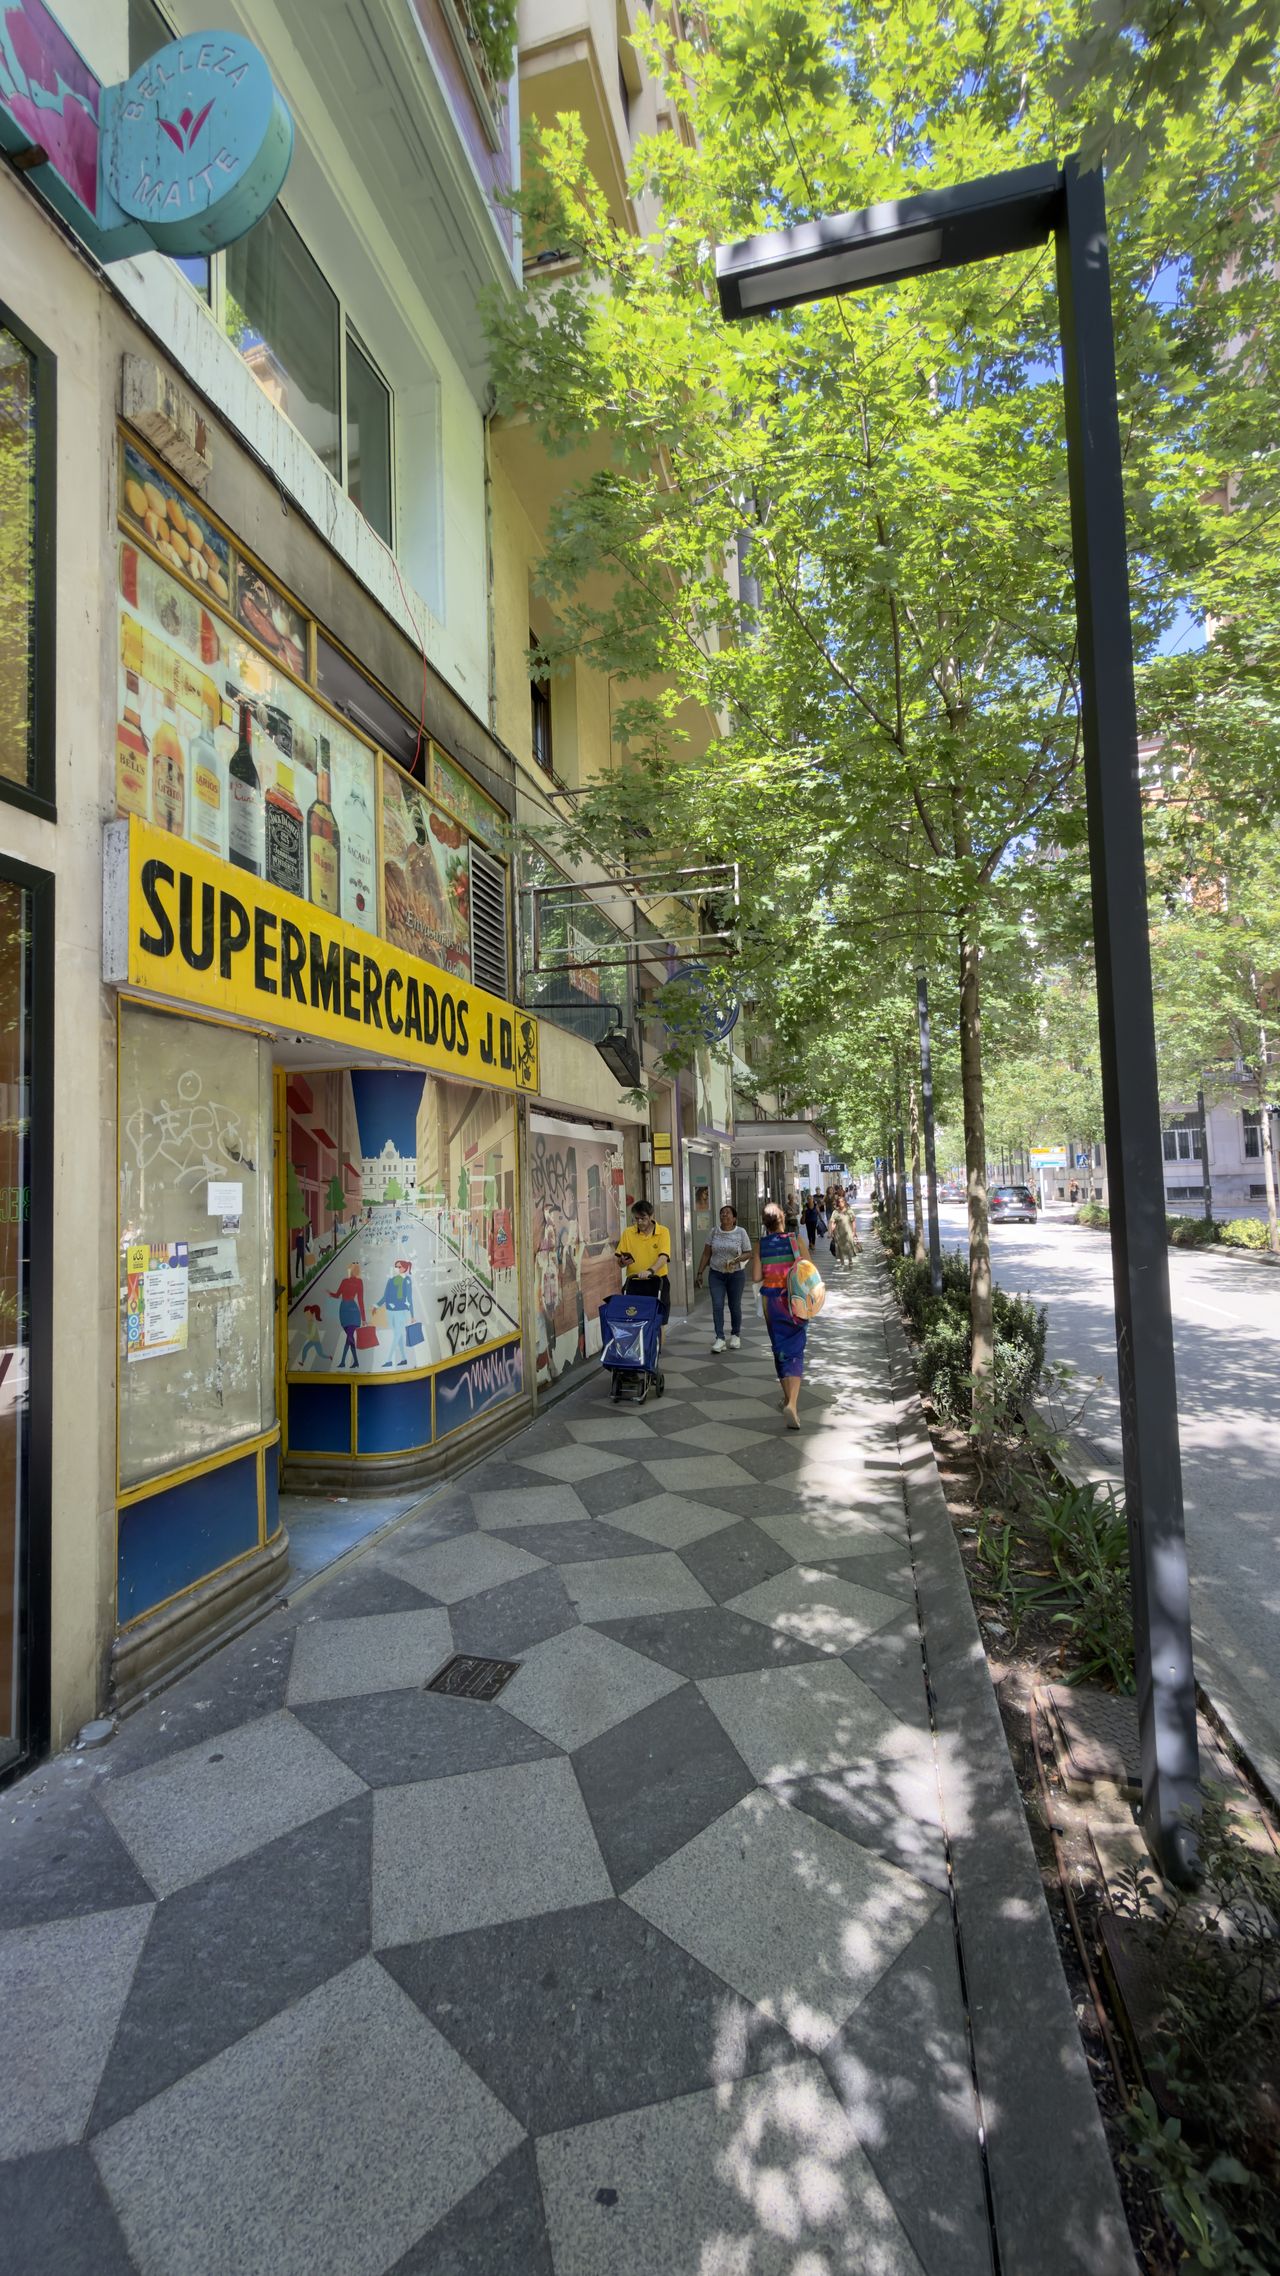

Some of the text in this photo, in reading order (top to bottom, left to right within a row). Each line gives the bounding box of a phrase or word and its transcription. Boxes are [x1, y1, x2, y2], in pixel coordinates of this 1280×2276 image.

[123, 44, 250, 121] BELLEZA
[133, 147, 240, 209] MAITE
[139, 859, 469, 1056] SUPERMERCADOS
